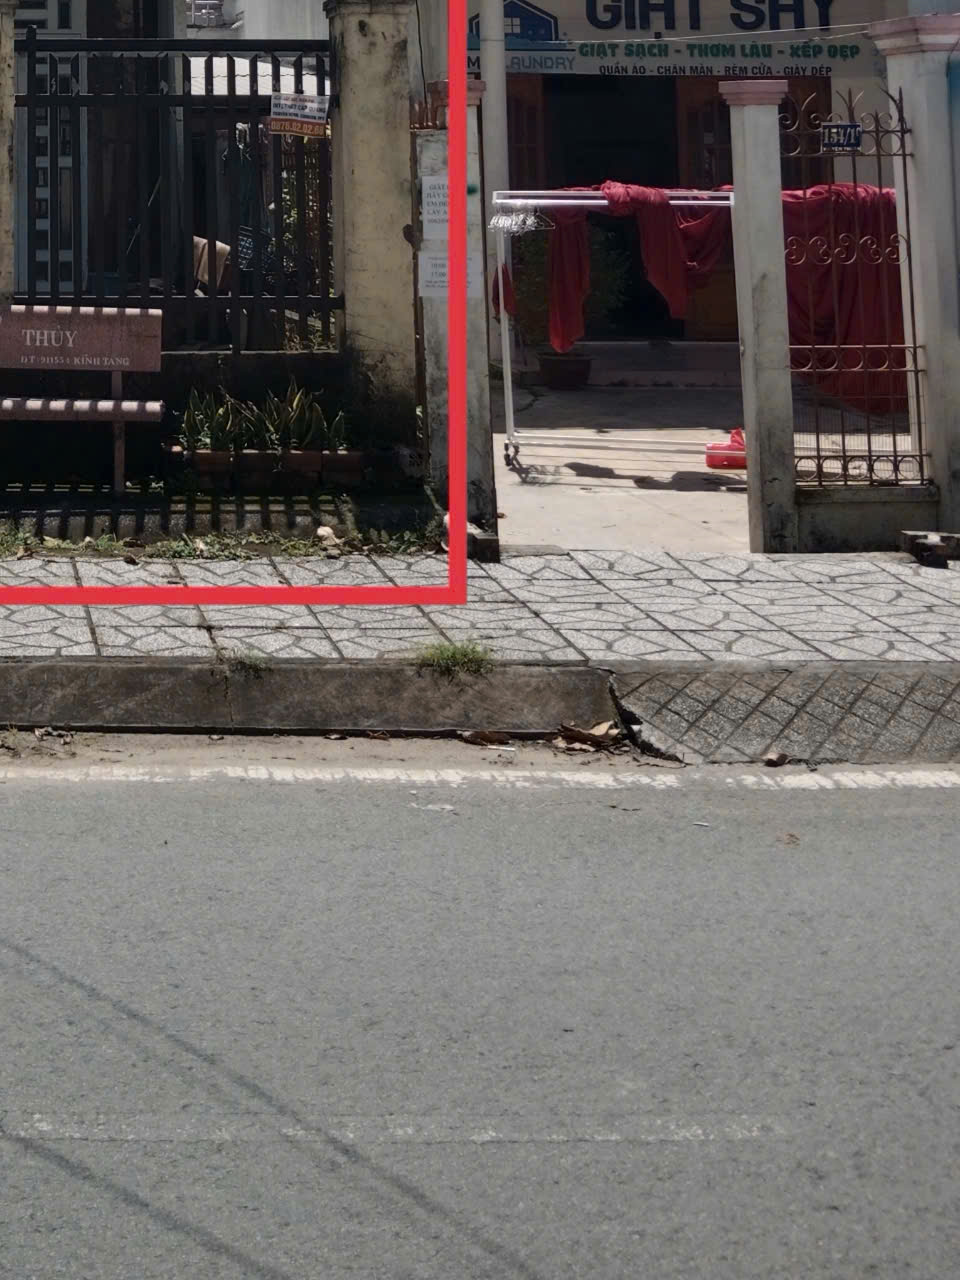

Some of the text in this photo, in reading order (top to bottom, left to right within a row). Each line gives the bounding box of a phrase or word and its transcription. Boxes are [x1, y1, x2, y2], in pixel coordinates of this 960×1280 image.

[624, 43, 669, 60] SẠCH
[686, 43, 735, 58] THƠM
[506, 56, 575, 70] AUNDRY
[811, 64, 832, 76] DÉP
[22, 324, 79, 348] THỦY
